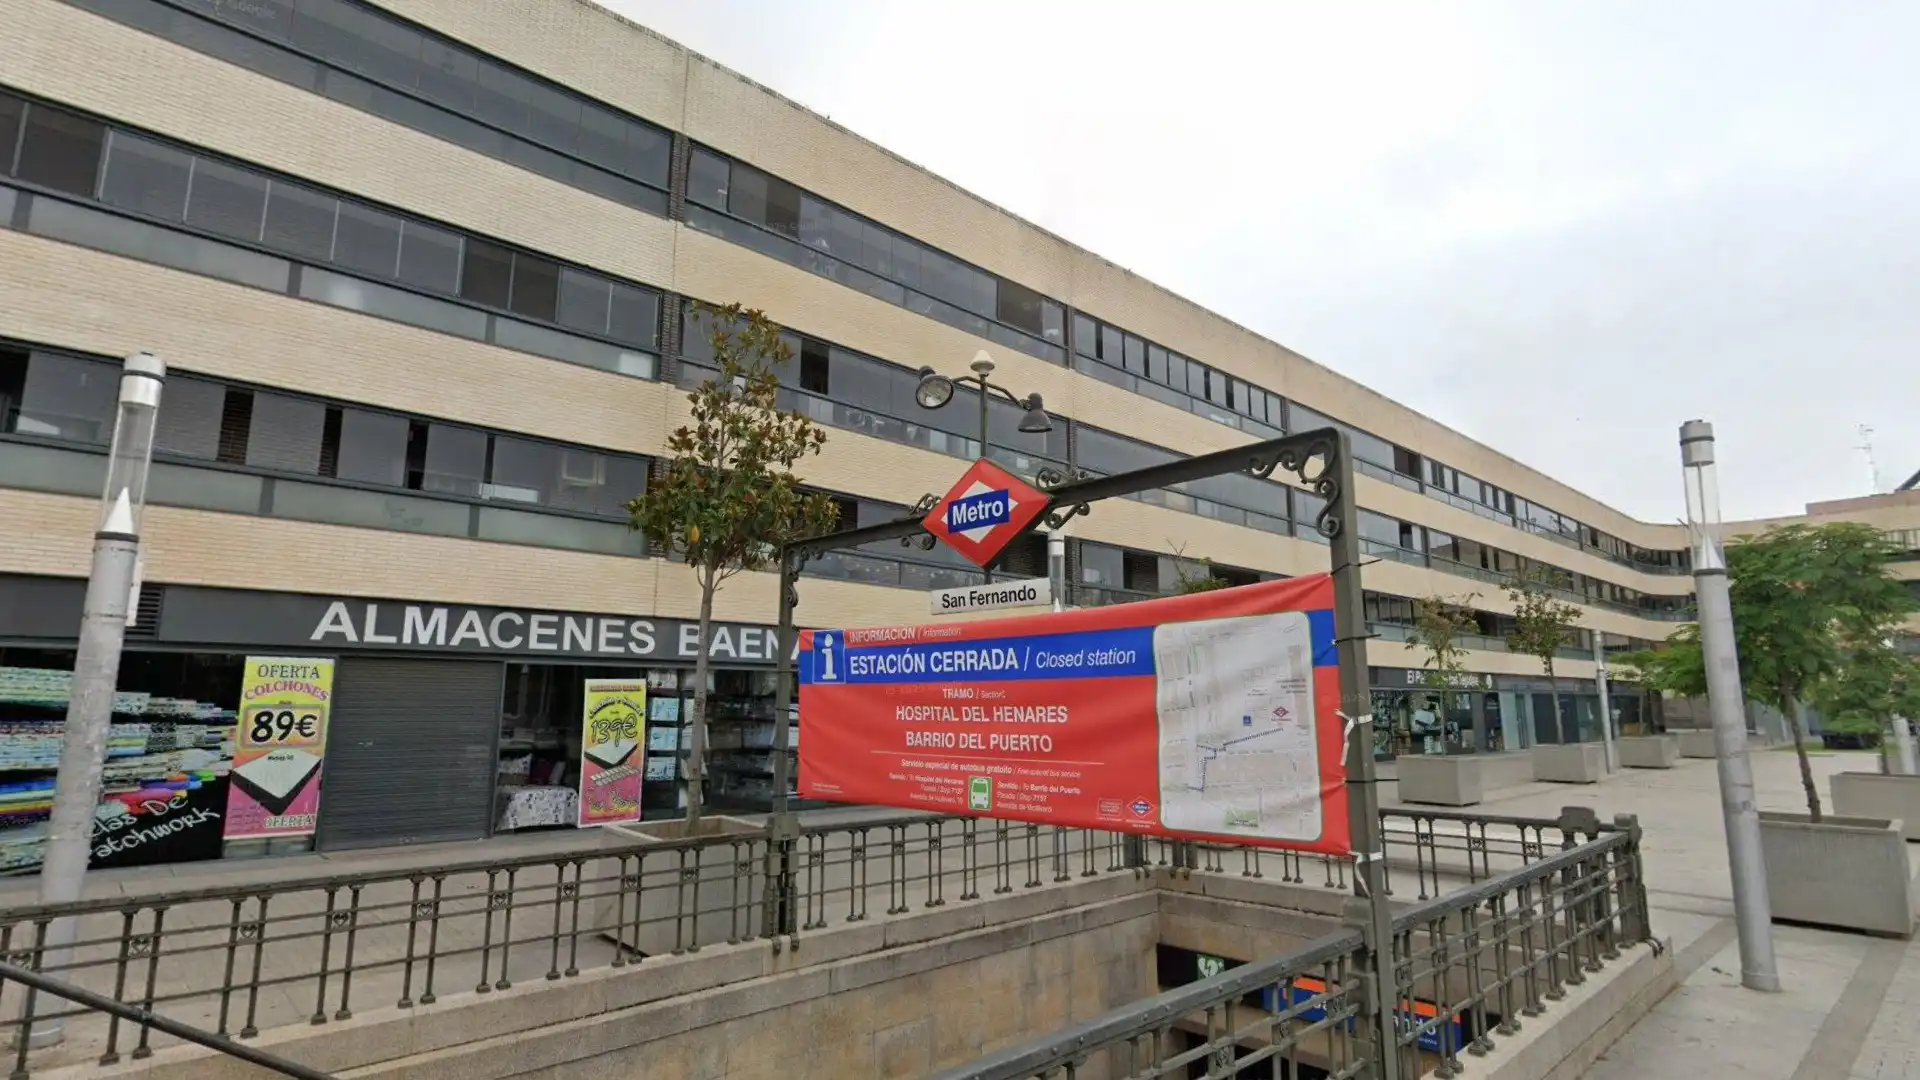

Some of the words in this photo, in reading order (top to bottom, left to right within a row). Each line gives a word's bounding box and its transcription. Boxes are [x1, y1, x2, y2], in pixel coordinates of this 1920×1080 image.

[952, 500, 1003, 526] Metro
[942, 593, 966, 608] San
[970, 585, 1037, 606] Fernando
[310, 601, 656, 654] ALMACENES
[257, 664, 320, 679] OFERTA
[850, 648, 926, 675] ESTACIÓN
[930, 648, 1019, 673] CERRADA
[1023, 646, 1030, 671] /
[1036, 650, 1084, 668] Closed
[1087, 648, 1136, 667] station
[244, 680, 329, 701] COLCHONES
[943, 688, 974, 699] TRAMO
[896, 705, 959, 722] HOSPITAL
[962, 706, 989, 722] DEL
[993, 705, 1068, 723] HENARES
[250, 710, 318, 743] 89€
[905, 731, 955, 749] BARRIO
[959, 734, 986, 749] DEL
[990, 734, 1053, 753] PUERTO
[901, 759, 924, 769] Servicio
[925, 762, 950, 771] especial
[950, 763, 959, 771] de
[1030, 783, 1048, 793] Barrio
[1048, 784, 1059, 793] del
[1059, 785, 1081, 795] Puerto
[140, 794, 189, 816] De
[94, 807, 221, 858] atchwork
